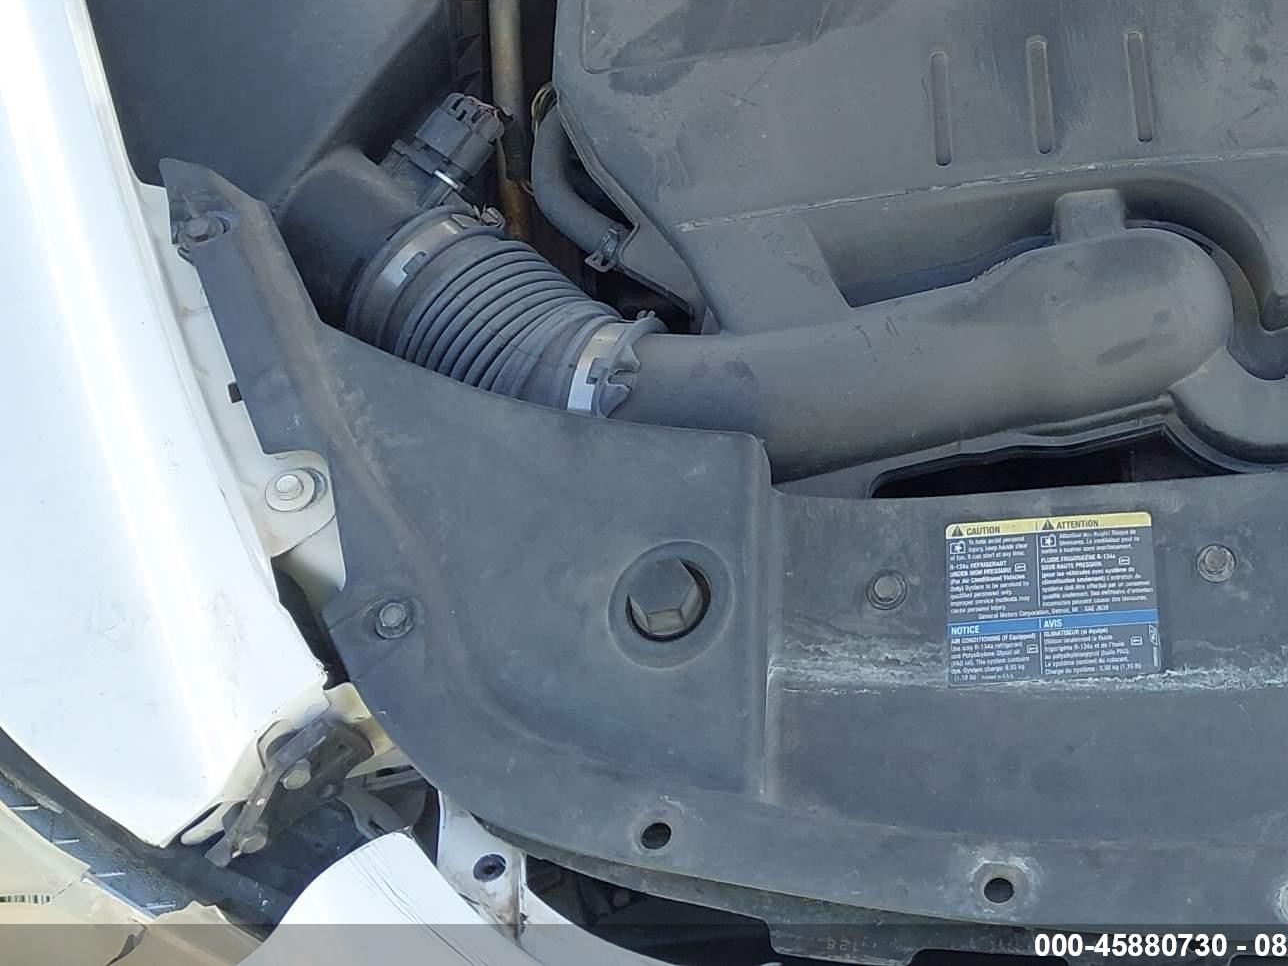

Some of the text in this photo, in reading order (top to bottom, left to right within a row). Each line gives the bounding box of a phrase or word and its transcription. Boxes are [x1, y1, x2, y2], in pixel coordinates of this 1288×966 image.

[1056, 520, 1098, 529] ATTENTION
[966, 526, 1000, 535] CAUTION
[1044, 620, 1063, 628] AVIS
[951, 626, 979, 634] NOTICE
